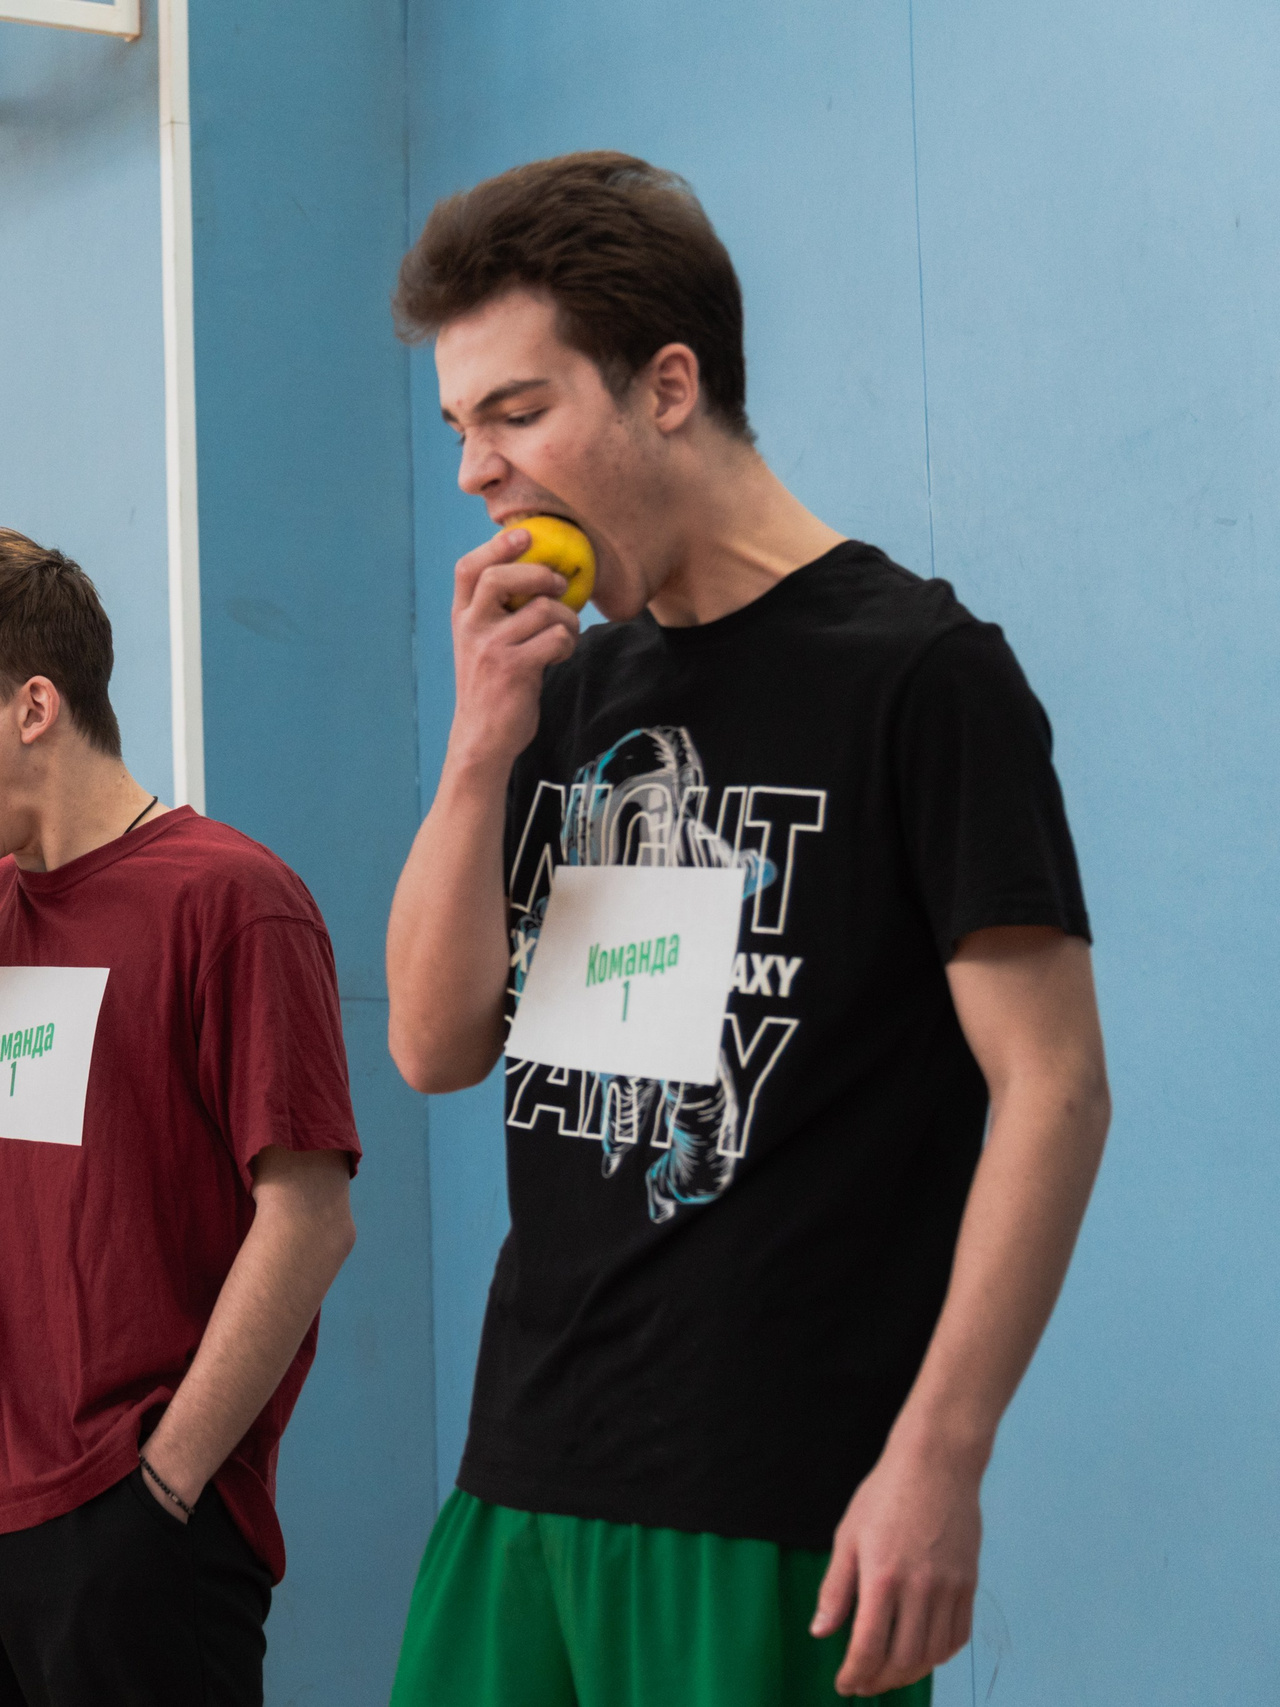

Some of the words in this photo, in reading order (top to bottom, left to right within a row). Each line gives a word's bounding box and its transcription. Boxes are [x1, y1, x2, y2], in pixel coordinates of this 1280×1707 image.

[586, 933, 680, 988] Команда
[728, 952, 804, 998] AXY
[622, 980, 630, 1022] 1
[10, 1061, 17, 1097] 1
